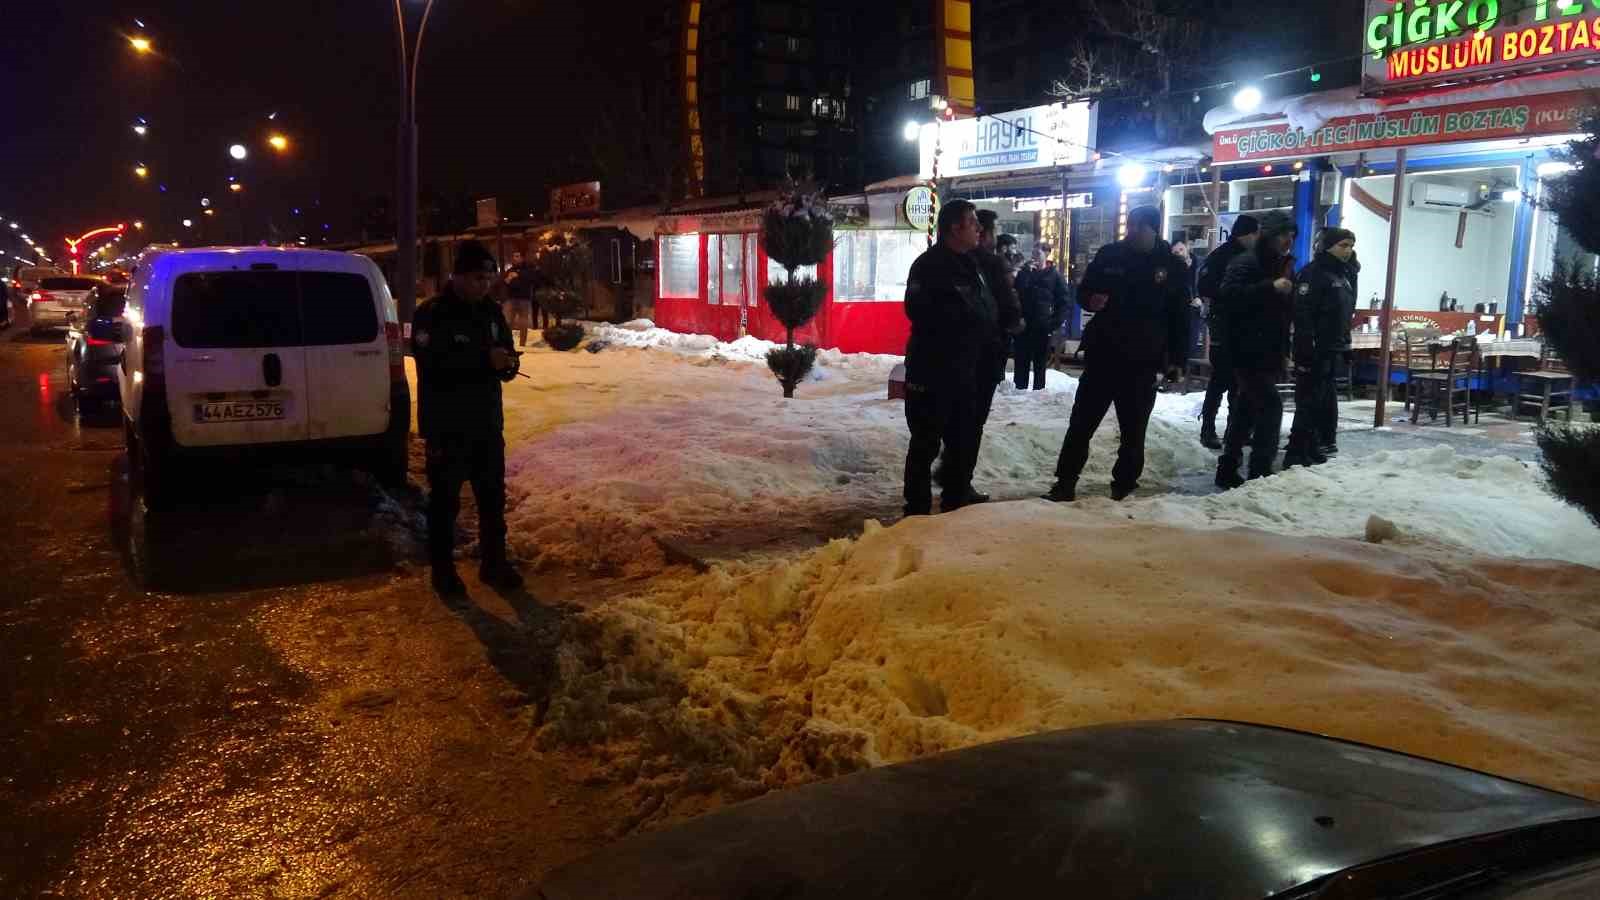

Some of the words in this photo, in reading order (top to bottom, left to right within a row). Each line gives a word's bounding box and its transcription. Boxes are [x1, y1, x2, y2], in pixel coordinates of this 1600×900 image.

[1387, 35, 1493, 80] MÜSLÜM
[976, 115, 1038, 152] HAYAL
[1358, 111, 1440, 141] MÜSLÜM
[1445, 104, 1529, 133] BOZTAŞ
